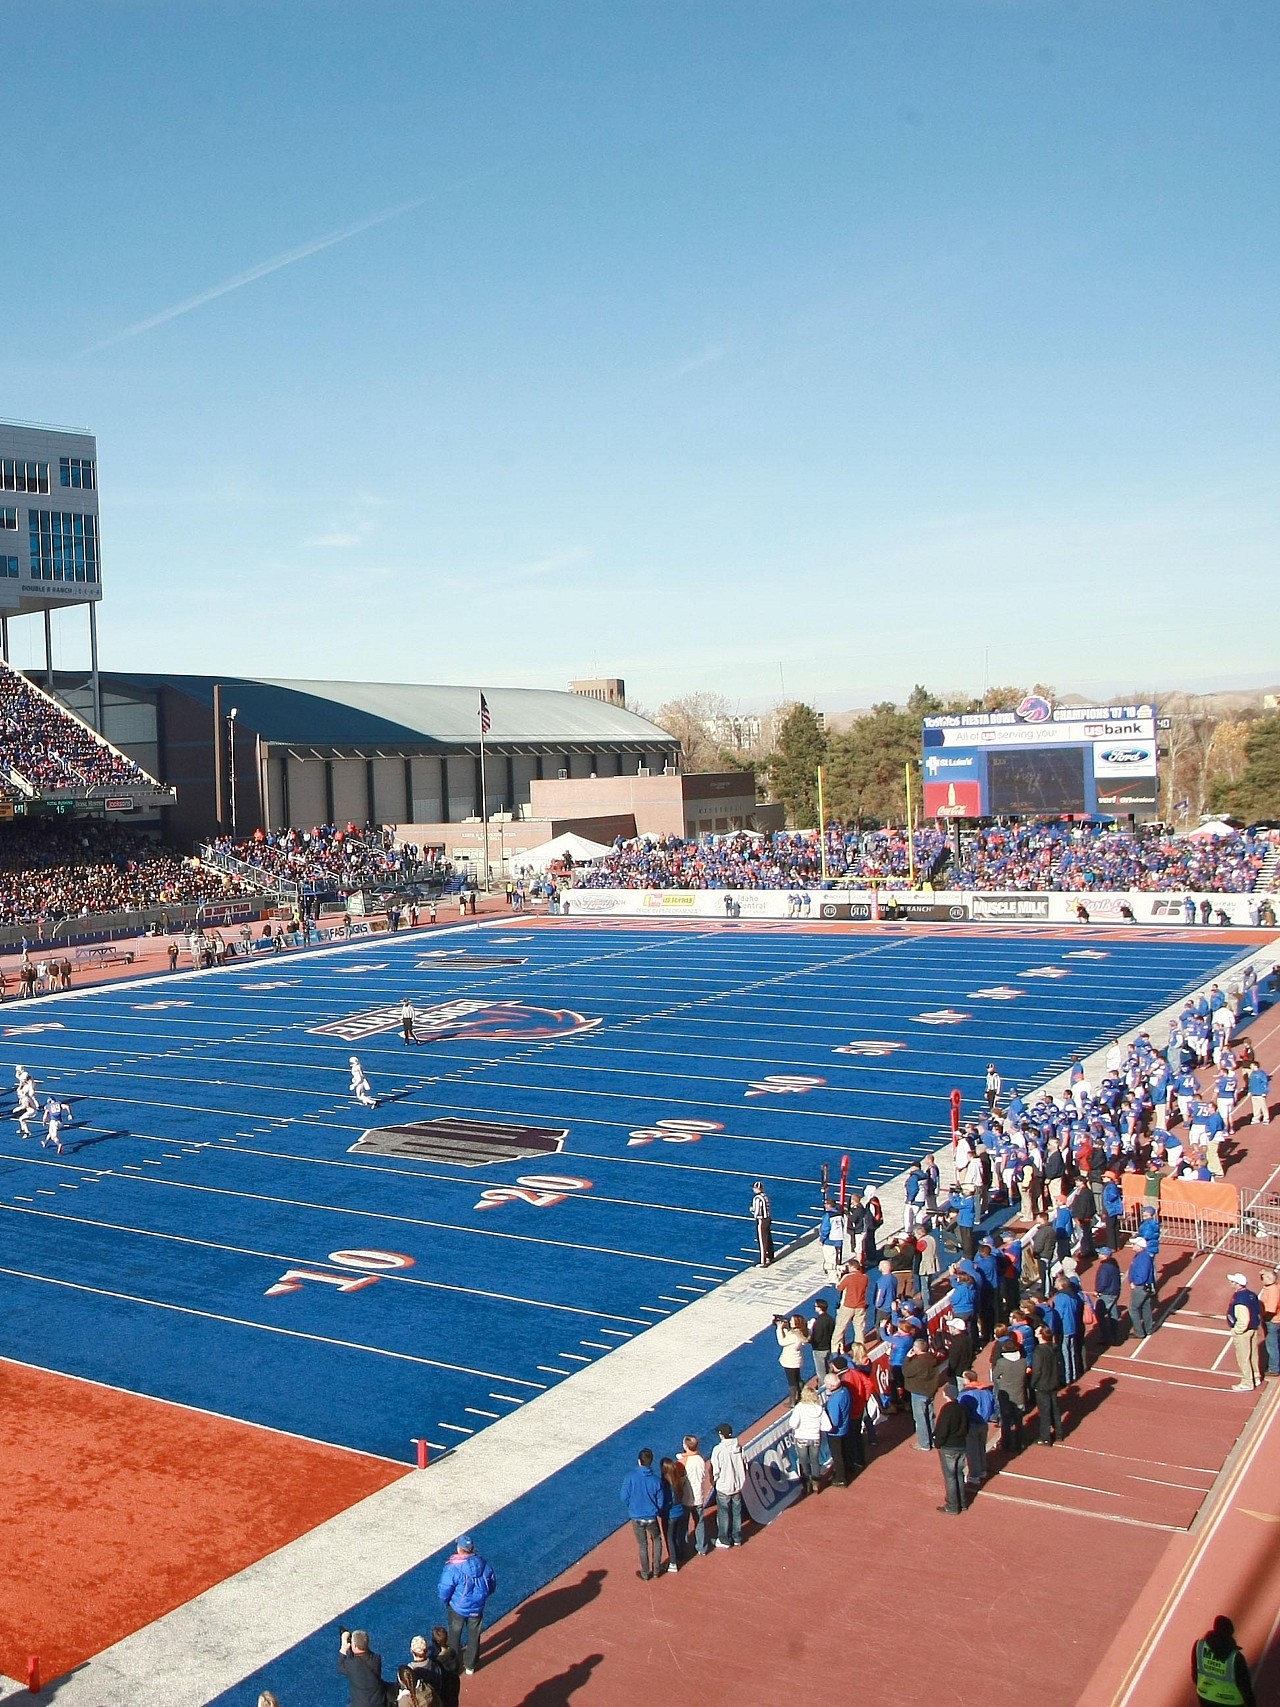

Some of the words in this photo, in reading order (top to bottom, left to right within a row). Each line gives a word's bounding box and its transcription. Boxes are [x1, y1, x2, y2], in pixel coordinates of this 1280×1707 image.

[962, 714, 989, 726] FIESTA
[990, 712, 1016, 724] BOWL
[1053, 708, 1109, 721] CHAMPIONS
[1157, 719, 1170, 728] 40
[956, 731, 968, 741] All
[970, 731, 979, 740] of
[995, 730, 1034, 742] serving
[1108, 749, 1140, 762] Ford
[14, 804, 24, 814] CAT
[56, 805, 65, 814] 15
[737, 894, 759, 902] Idaho
[974, 901, 1016, 914] MUSCLE
[1018, 901, 1048, 914] MILK
[831, 1039, 908, 1056] 50
[748, 1074, 827, 1094] 40
[1182, 1077, 1194, 1088] 44
[1225, 1081, 1236, 1092] 62
[1197, 1106, 1209, 1117] 75
[629, 1118, 726, 1144] 30
[479, 1173, 594, 1208] 20
[284, 1248, 417, 1294] 10
